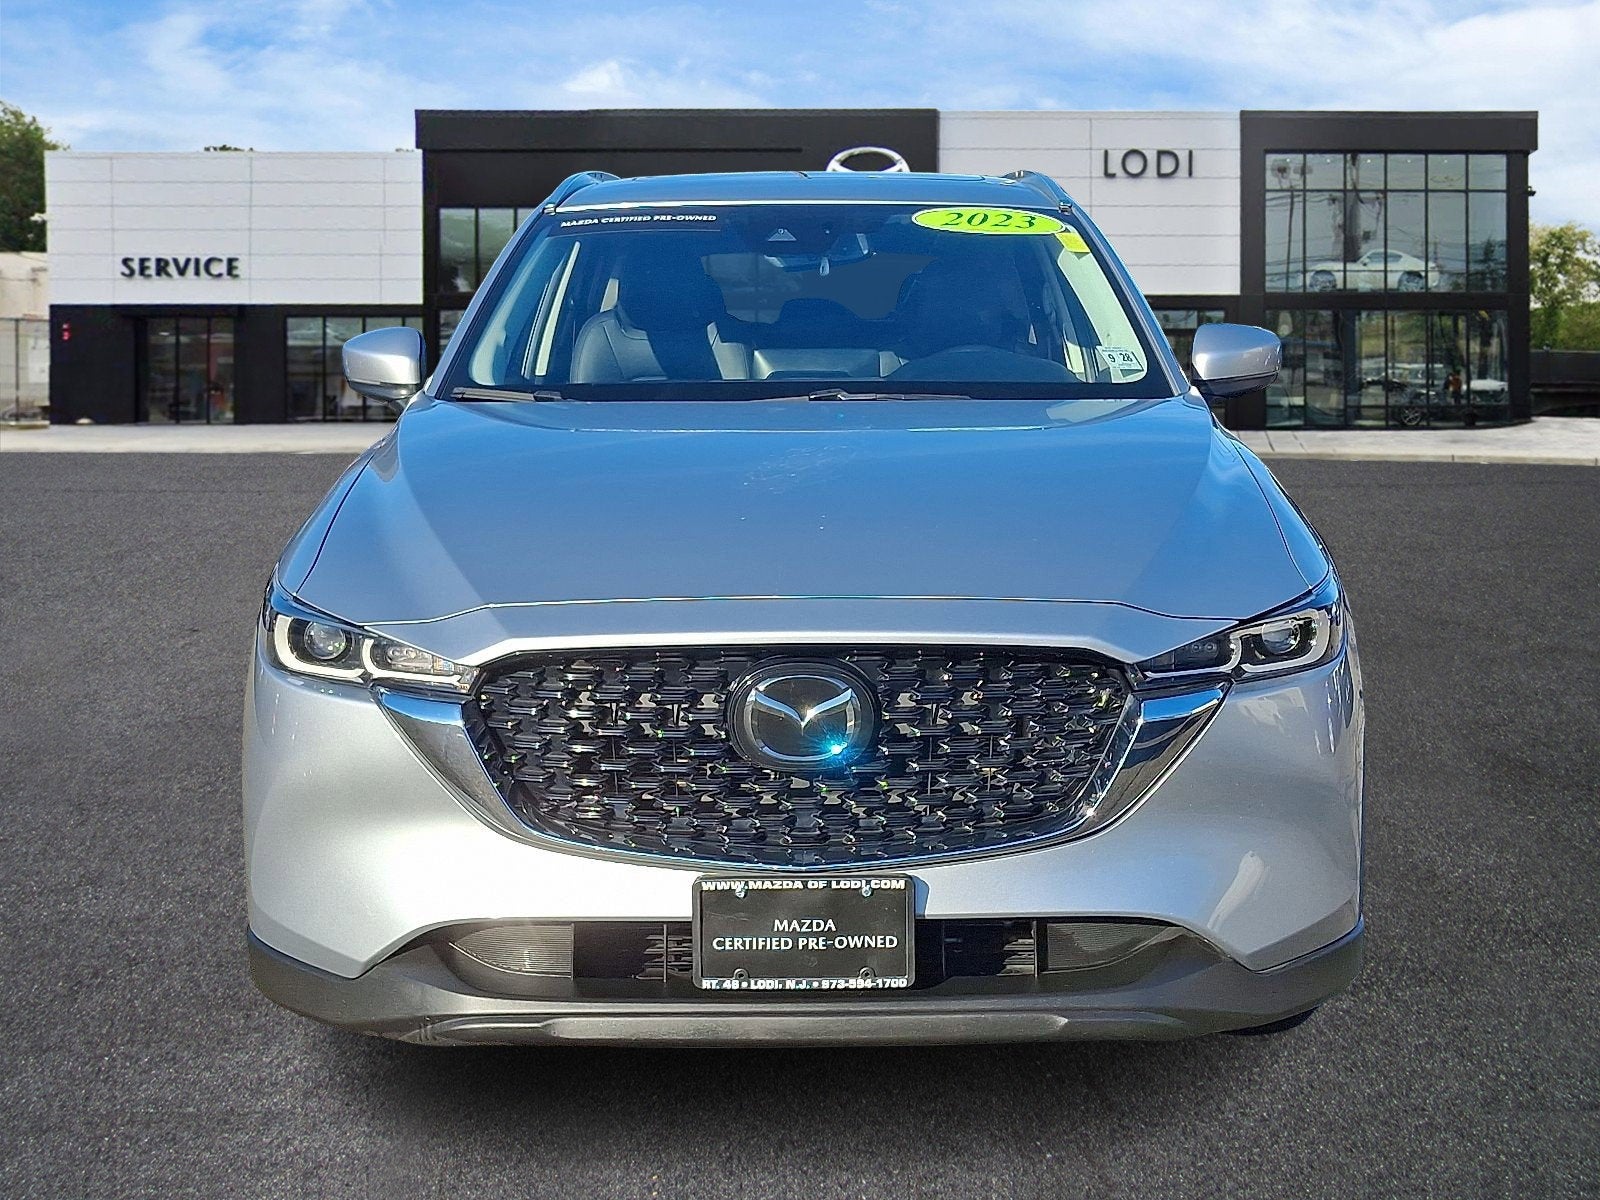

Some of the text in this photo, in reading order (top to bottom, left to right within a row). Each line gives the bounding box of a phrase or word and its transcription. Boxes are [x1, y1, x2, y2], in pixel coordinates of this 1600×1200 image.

[1103, 148, 1193, 178] LODI
[940, 211, 1036, 229] 2023
[120, 256, 240, 278] SERVICE
[807, 879, 828, 890] OF
[773, 918, 837, 933] MAZDA
[712, 935, 898, 951] CERTIFIED PRE-OWNED
[701, 979, 721, 990] RT.
[785, 979, 811, 990] N.J.
